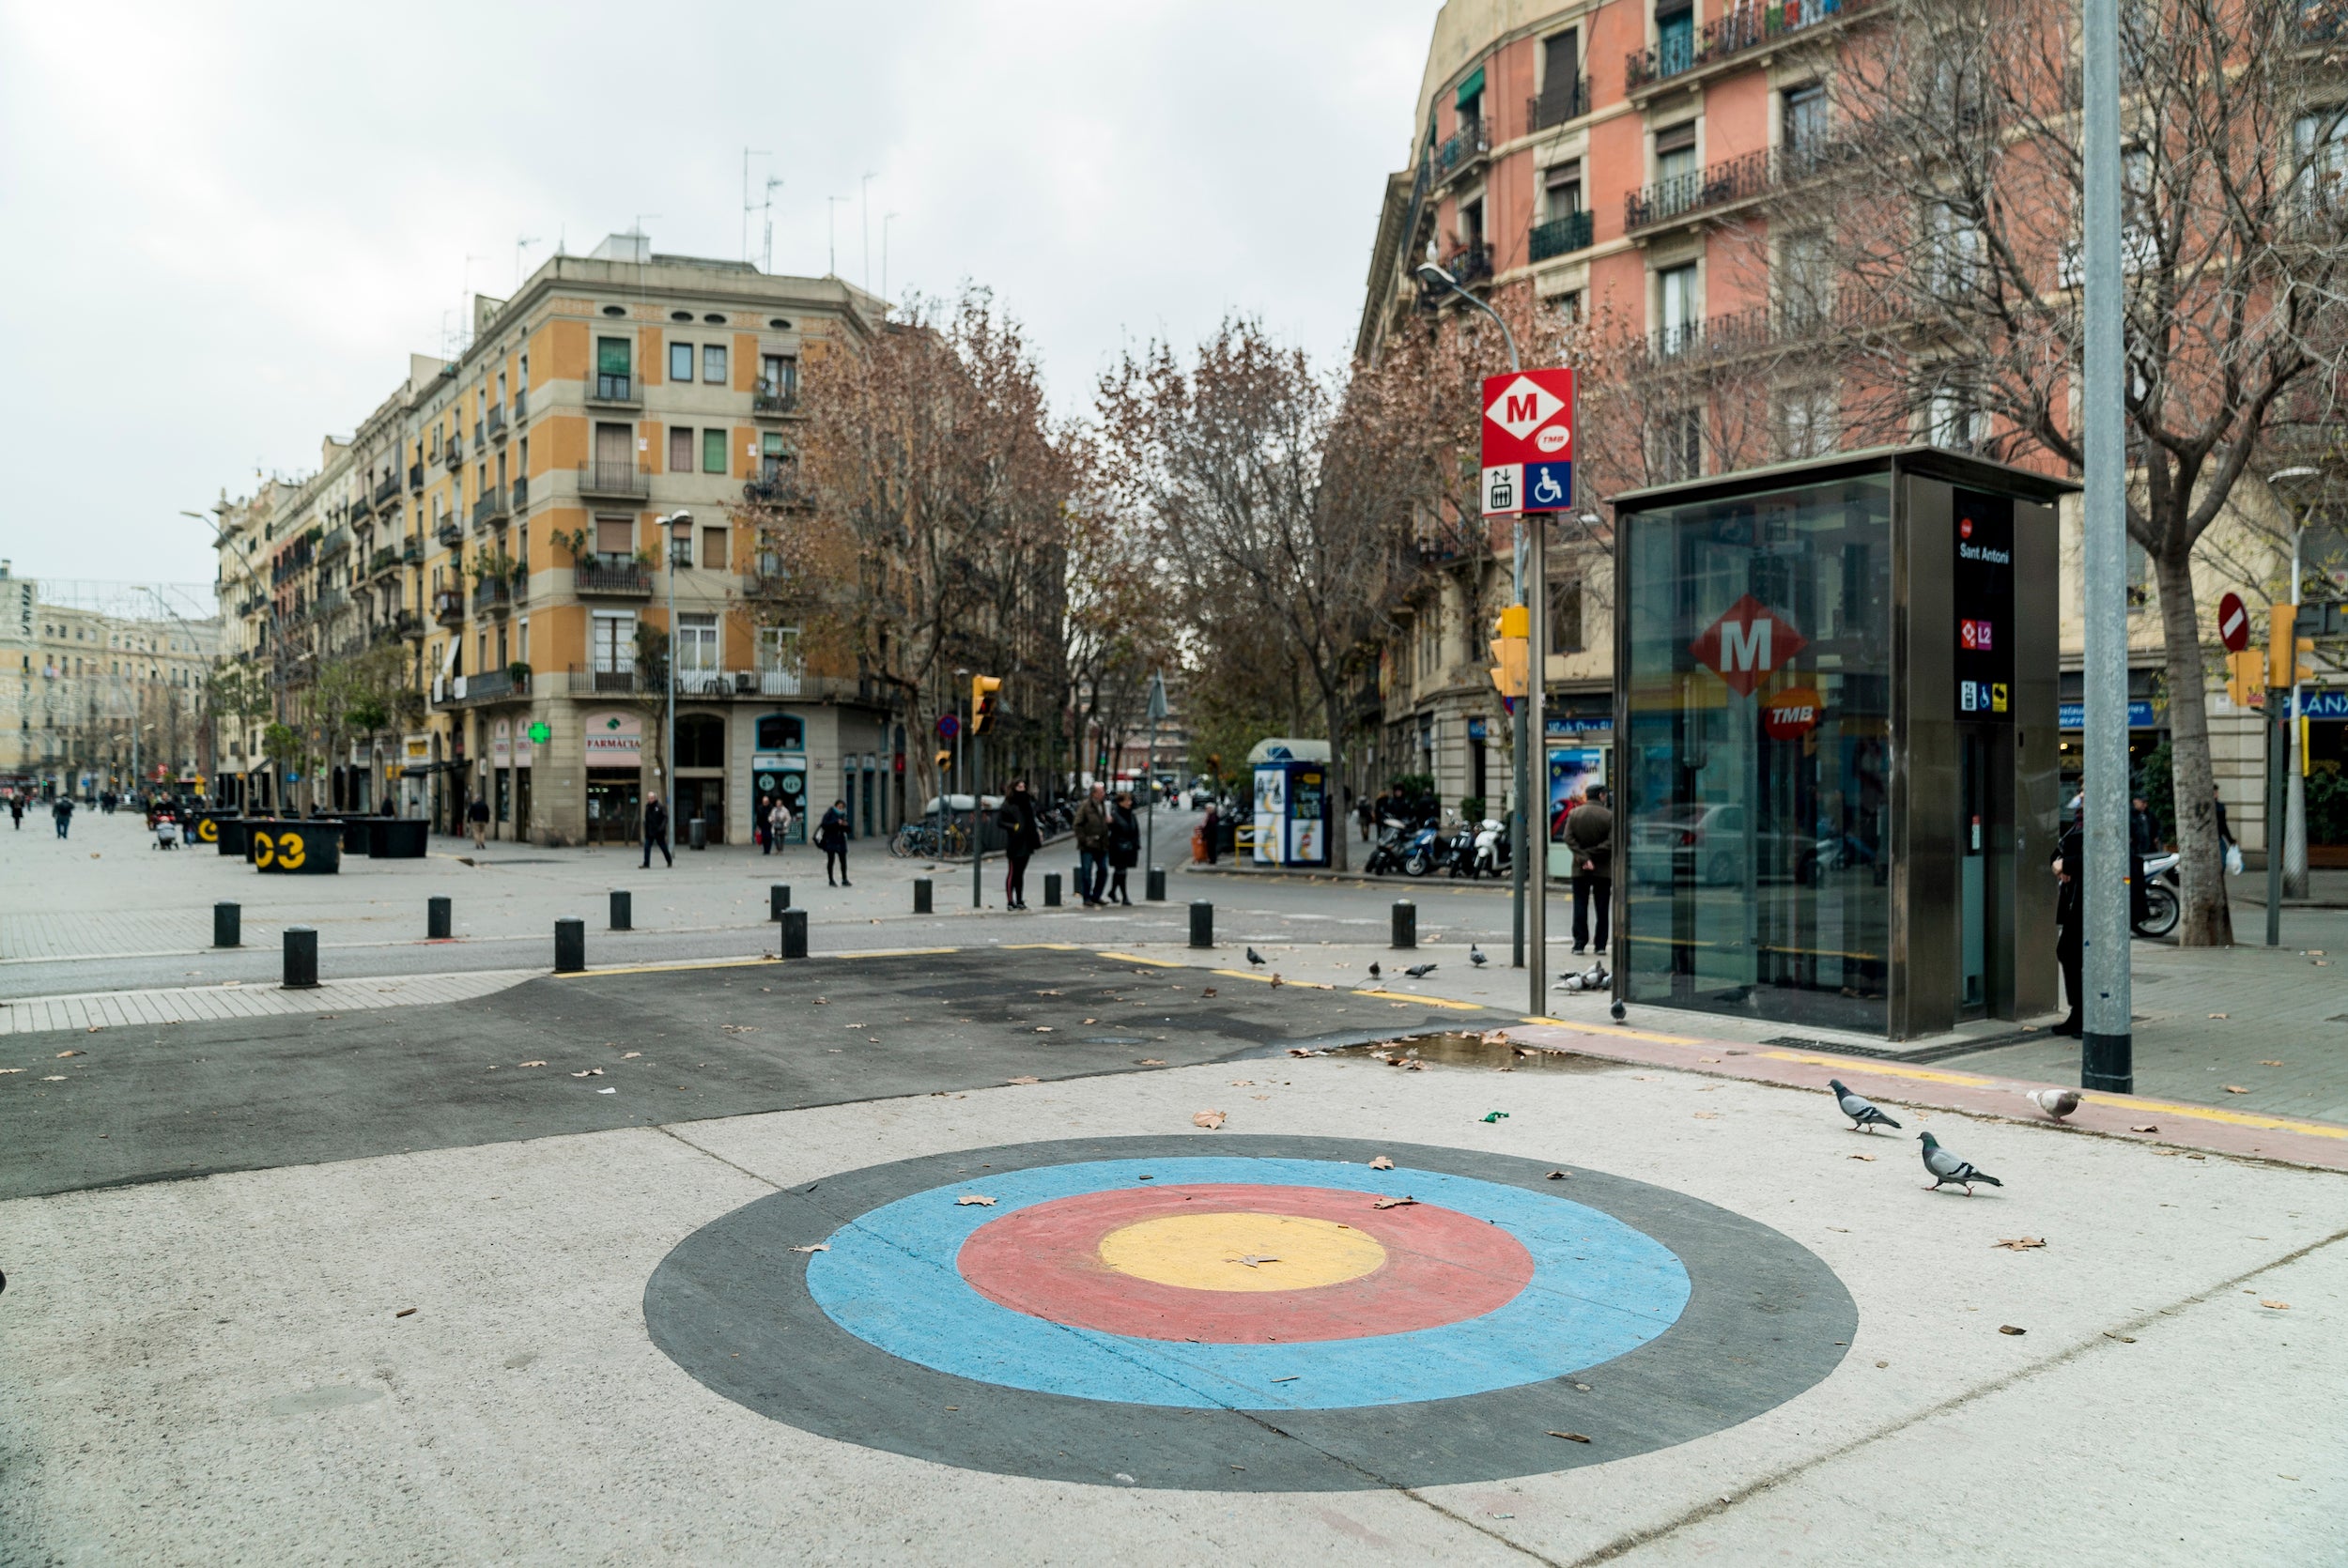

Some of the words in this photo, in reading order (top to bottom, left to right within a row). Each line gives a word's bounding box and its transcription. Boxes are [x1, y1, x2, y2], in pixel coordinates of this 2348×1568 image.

[1507, 393, 1537, 423] M
[1960, 542, 1981, 560] Sant
[1982, 546, 2009, 564] Antoni
[1978, 626, 1991, 644] L2
[1720, 620, 1772, 672] M
[1772, 706, 1814, 724] TMB
[587, 737, 641, 747] FARMÀCIA
